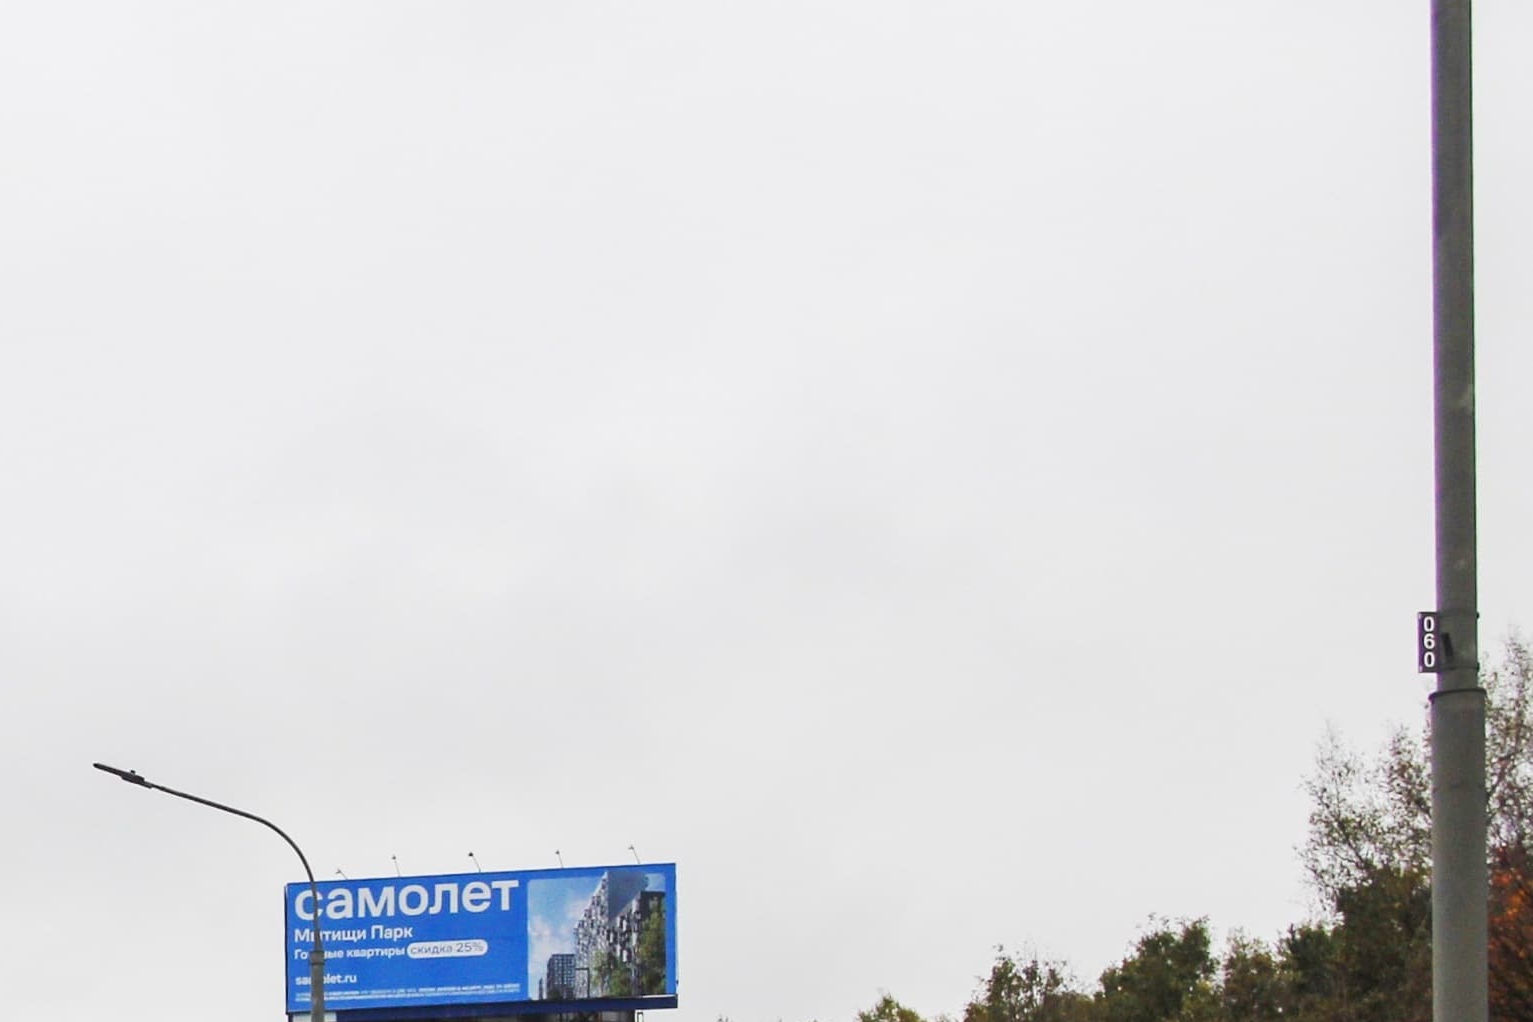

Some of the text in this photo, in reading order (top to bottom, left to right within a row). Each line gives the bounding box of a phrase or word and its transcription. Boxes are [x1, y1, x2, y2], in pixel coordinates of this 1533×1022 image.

[1423, 615, 1435, 668] 060
[294, 880, 520, 921] самолет
[370, 925, 413, 941] Парк
[294, 942, 484, 960] Гоые квартиры скидка 25%
[295, 974, 357, 986] salet.ru
